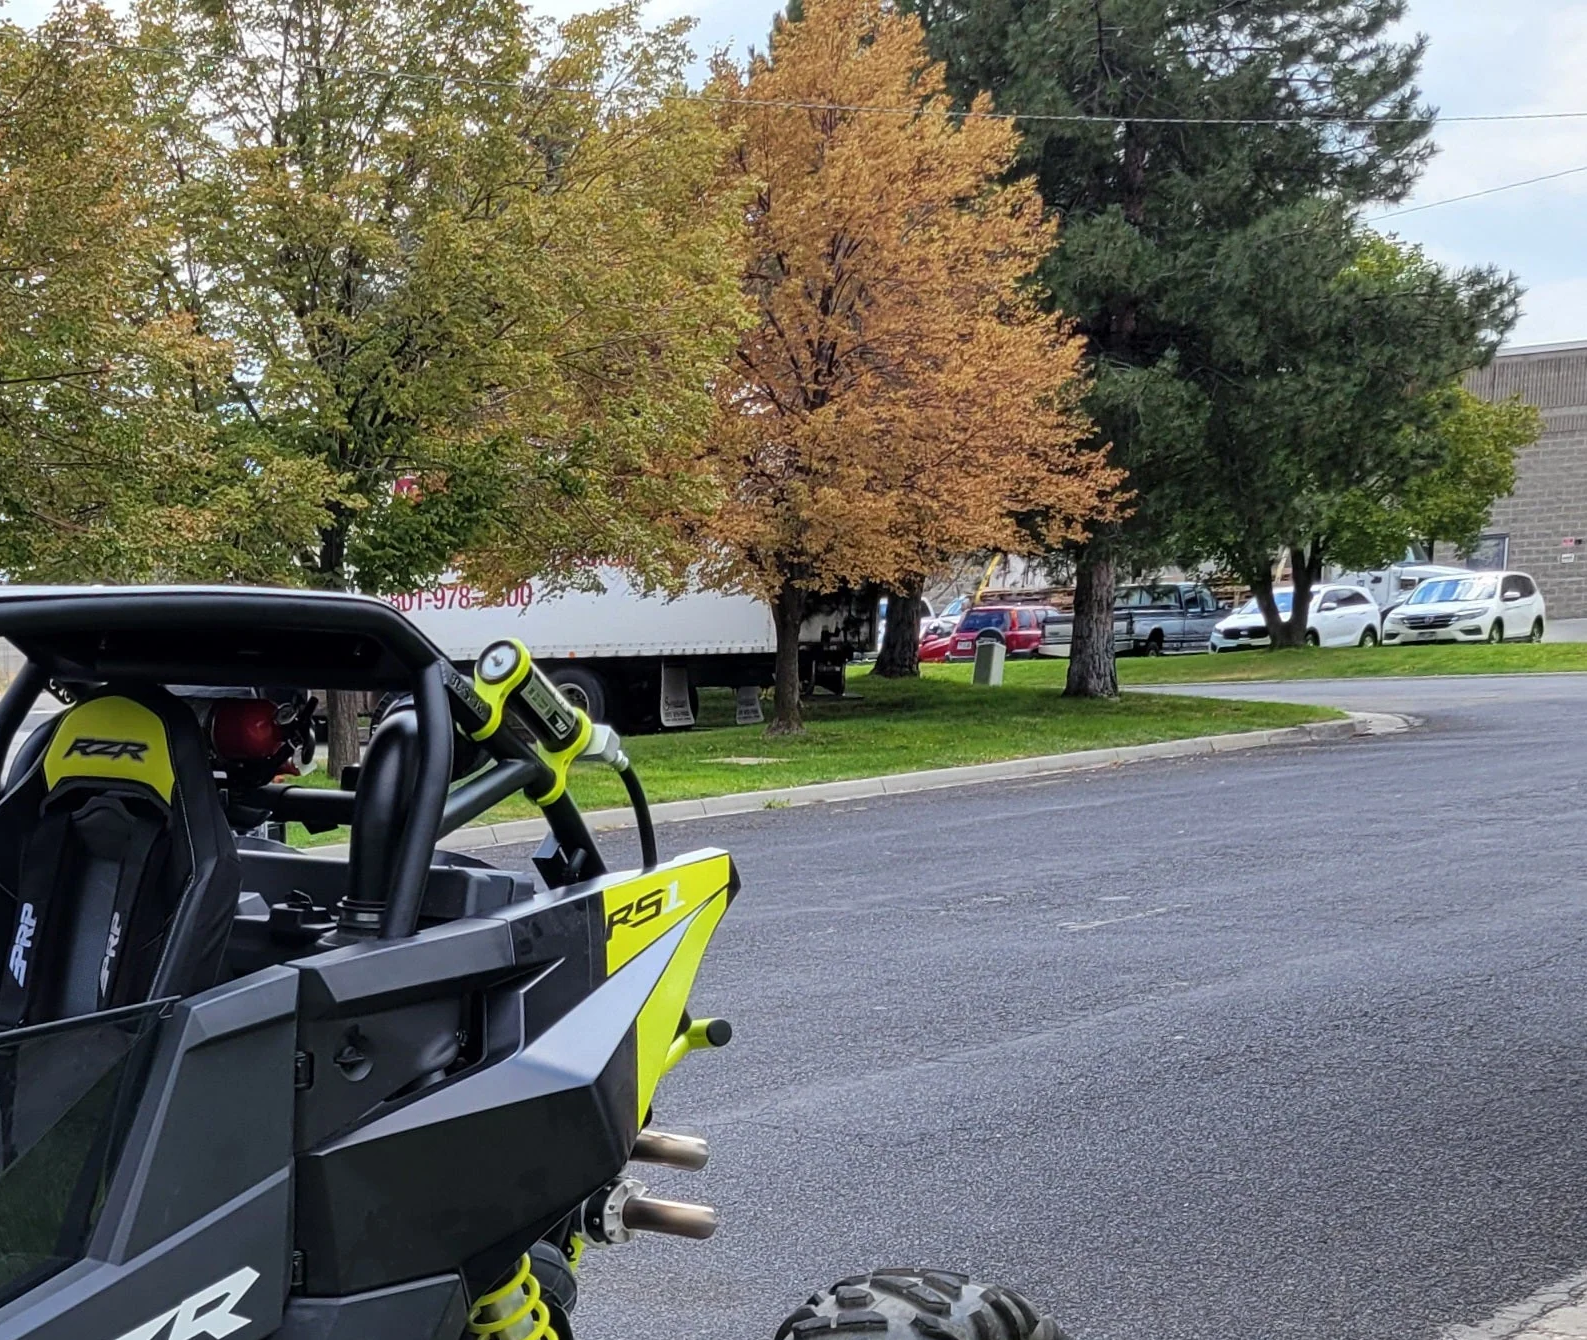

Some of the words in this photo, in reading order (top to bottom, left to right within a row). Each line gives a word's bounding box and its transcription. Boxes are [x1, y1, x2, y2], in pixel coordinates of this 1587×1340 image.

[389, 579, 533, 612] 801-978-00
[63, 737, 149, 763] RZR
[605, 880, 686, 941] RS1
